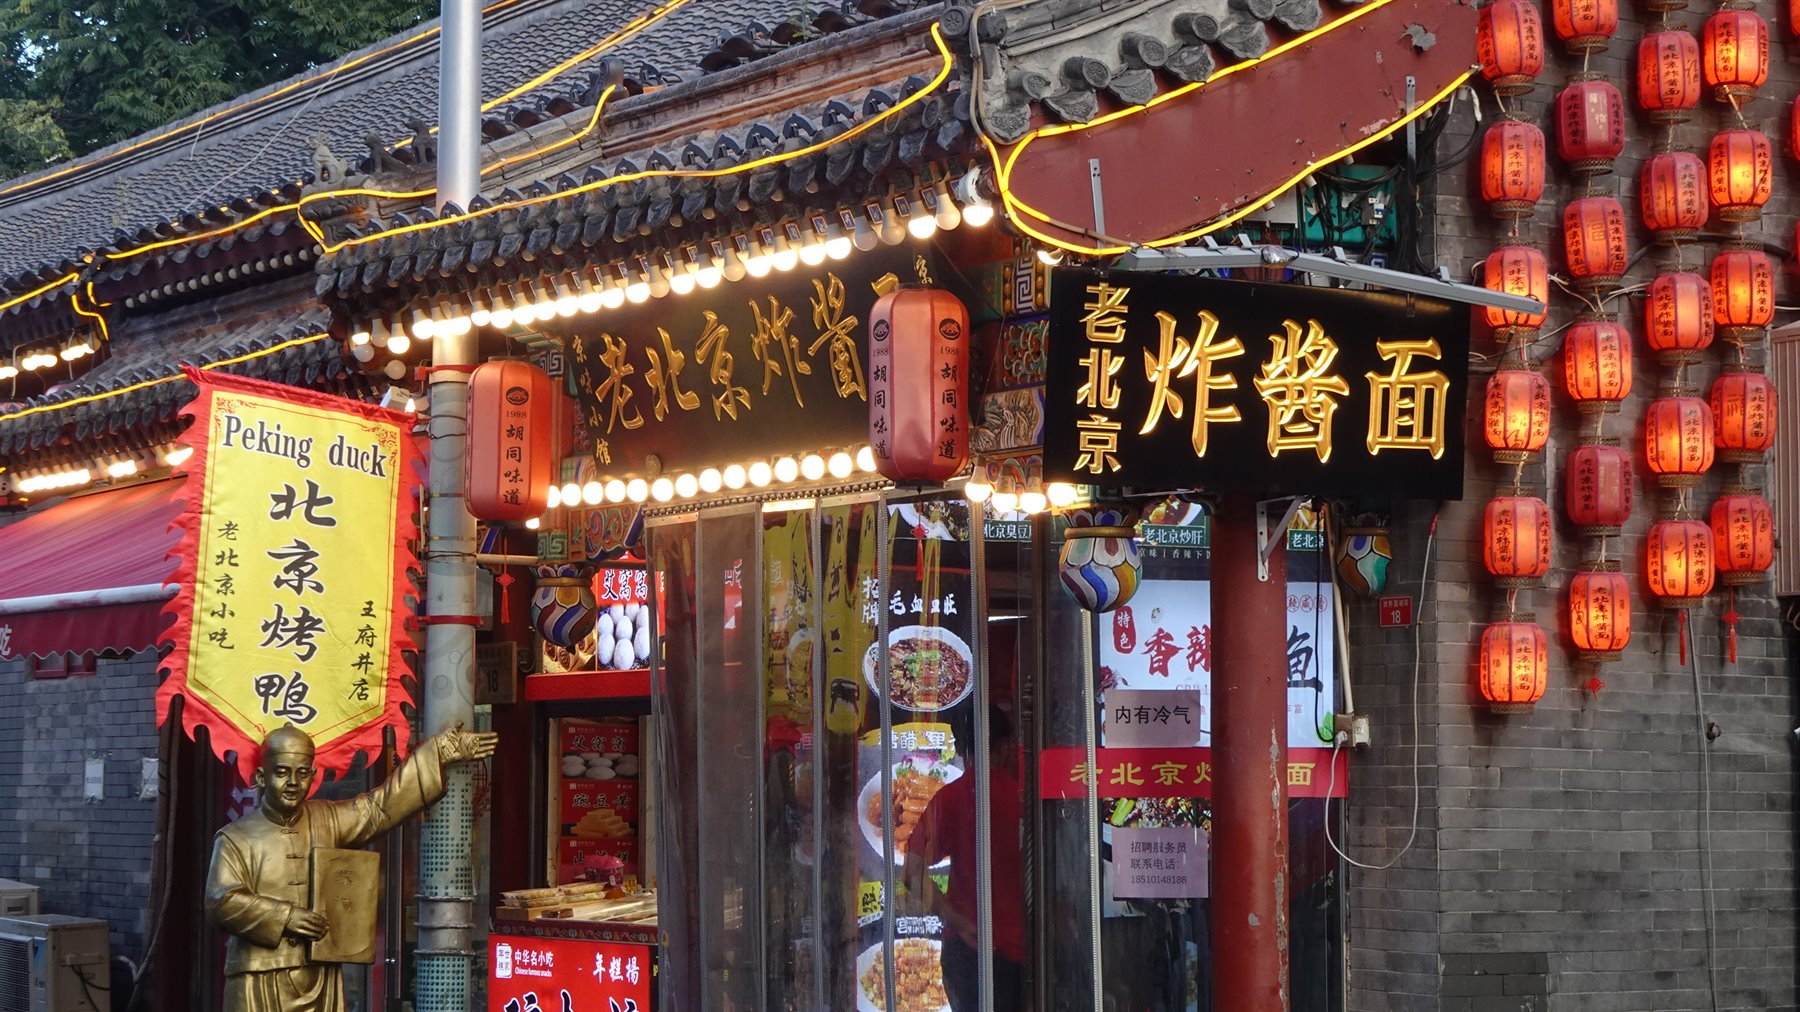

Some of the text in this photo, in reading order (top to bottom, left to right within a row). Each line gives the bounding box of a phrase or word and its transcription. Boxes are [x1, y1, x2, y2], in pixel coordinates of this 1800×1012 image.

[1073, 281, 1131, 475] 老北京
[505, 411, 527, 419] 1988
[873, 364, 891, 461] 胡同味道
[938, 362, 960, 461] 胡同味道
[223, 415, 388, 478] Peking duck
[503, 423, 524, 507] 胡同味道
[1143, 528, 1203, 545] 老北京炒肝
[208, 520, 240, 650] 老北京小吃
[254, 478, 337, 724] 北京烤鸭
[1117, 611, 1132, 649] 特色
[1391, 609, 1401, 624] 18
[347, 599, 378, 701] 王府井店
[1114, 705, 1192, 725] 内有冷气
[1070, 761, 1316, 786] 老北京面
[1130, 841, 1187, 854] 招聘服务员
[1130, 874, 1188, 884] 18510148188
[514, 948, 554, 967] 中华名小吃
